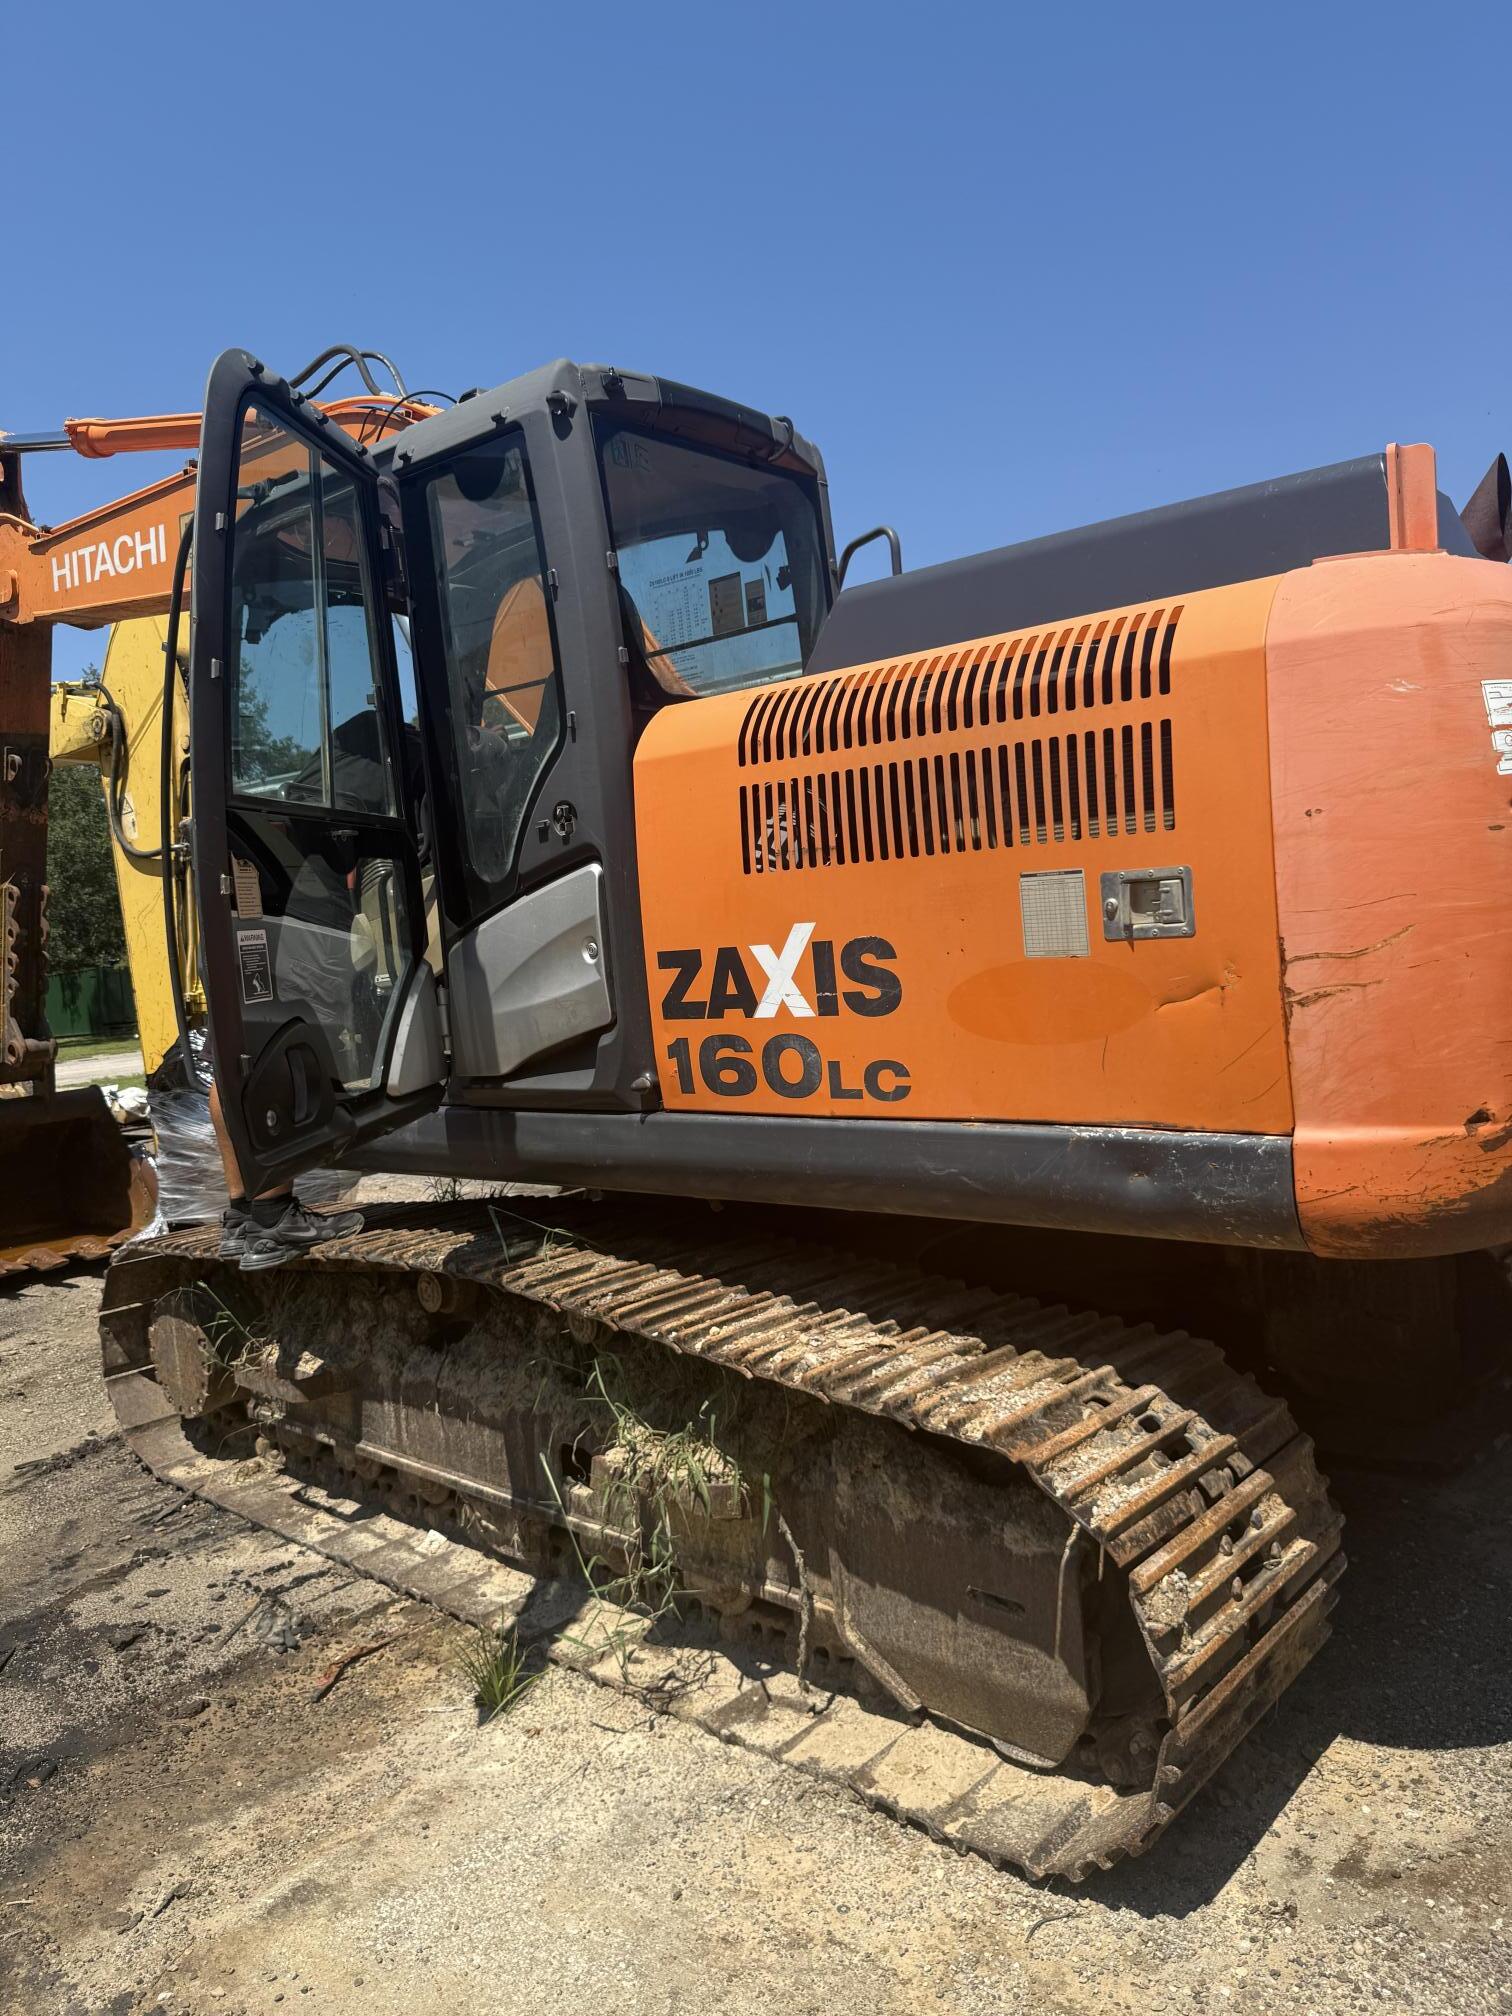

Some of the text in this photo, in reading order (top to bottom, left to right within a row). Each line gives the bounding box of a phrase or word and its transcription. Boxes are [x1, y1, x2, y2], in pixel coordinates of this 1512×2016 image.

[51, 524, 167, 592] HITACHI
[657, 922, 902, 1020] ZAXIS
[667, 1033, 912, 1102] 160LC
